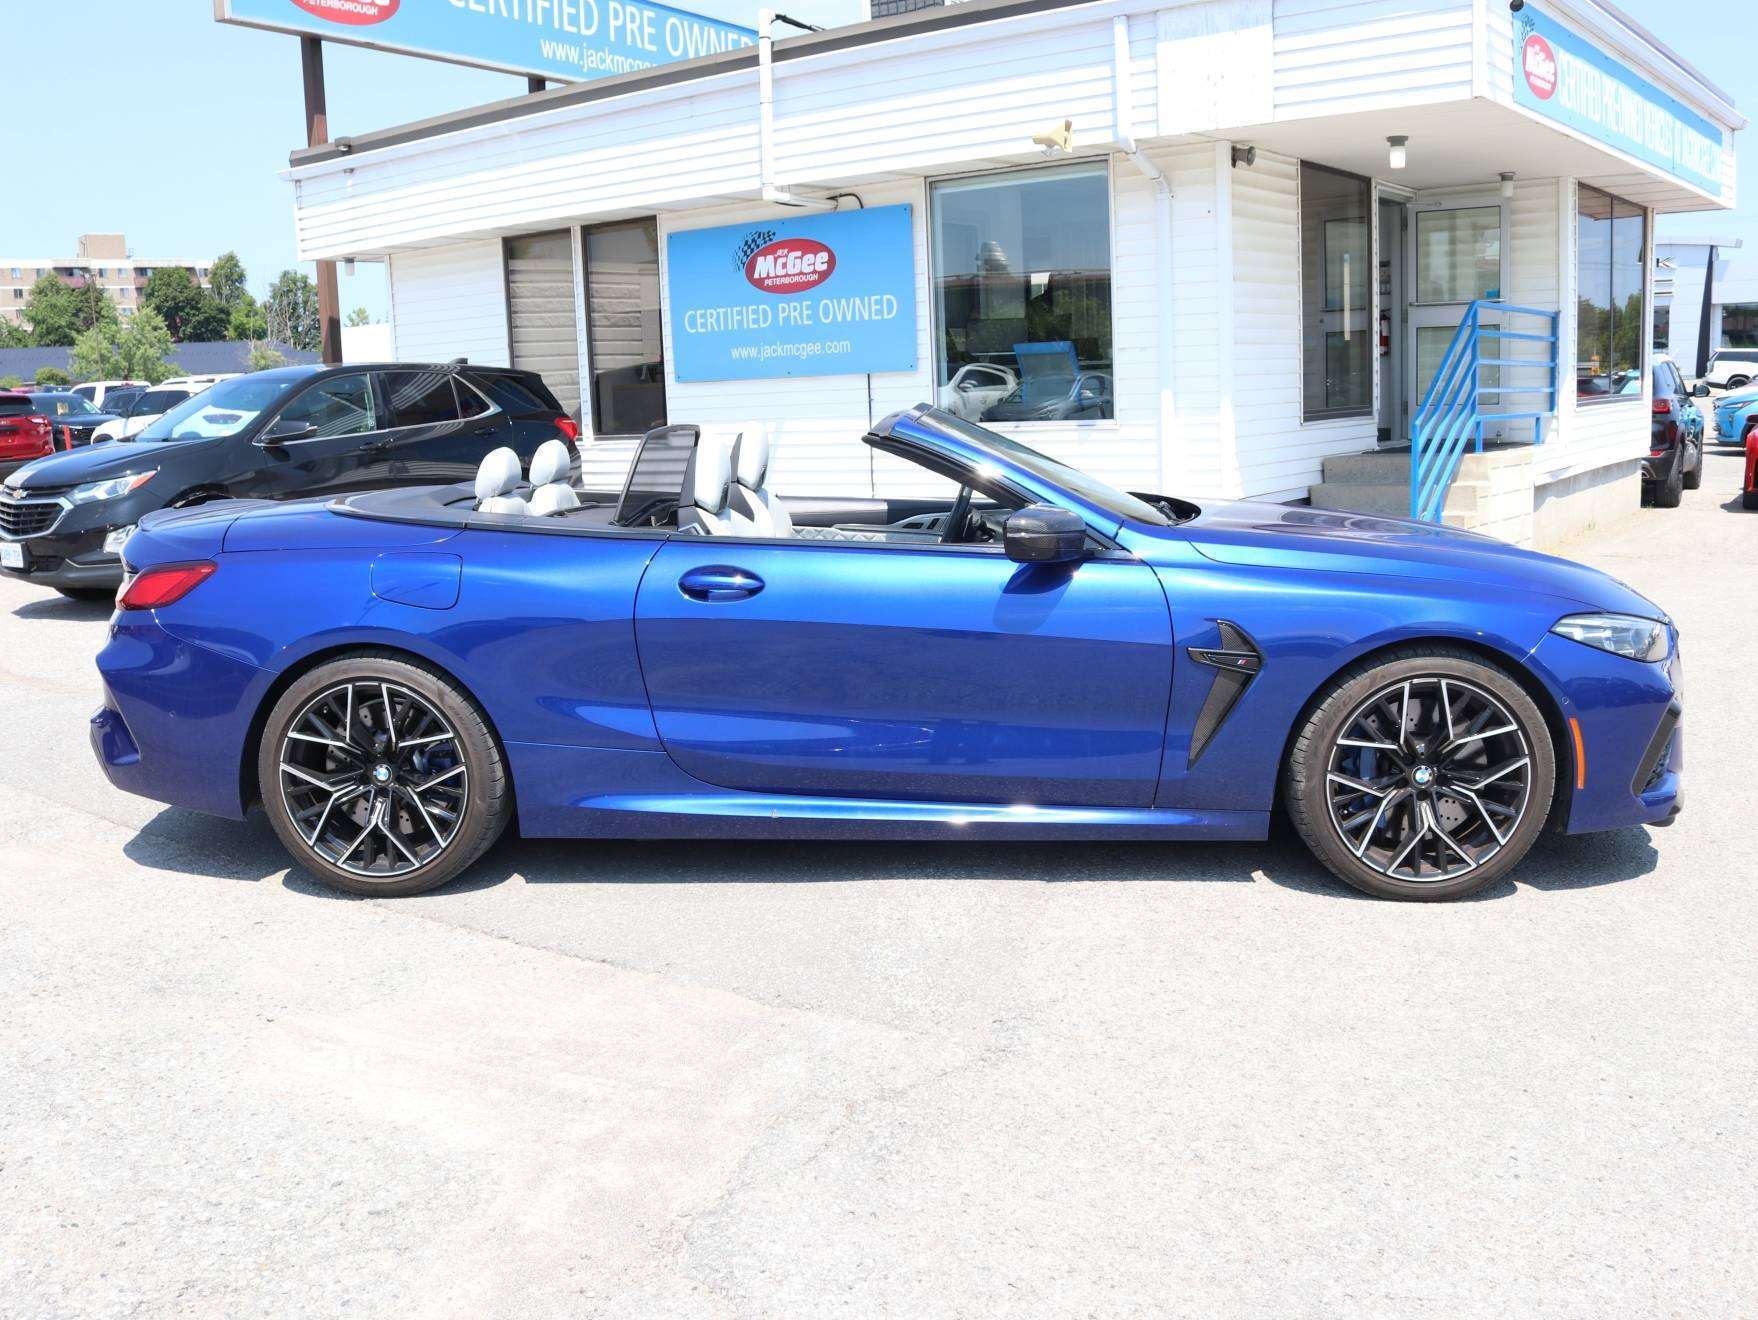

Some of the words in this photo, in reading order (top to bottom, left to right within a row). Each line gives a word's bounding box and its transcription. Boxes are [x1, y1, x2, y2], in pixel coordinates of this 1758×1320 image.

[609, 1, 657, 51] PRE
[753, 250, 829, 279] McGee
[764, 273, 819, 287] PETERBOROUGH
[684, 304, 773, 334] CERTIFIED
[778, 300, 814, 328] PRE
[818, 294, 898, 324] OWNED
[730, 339, 852, 361] www.jackmcgee.com
